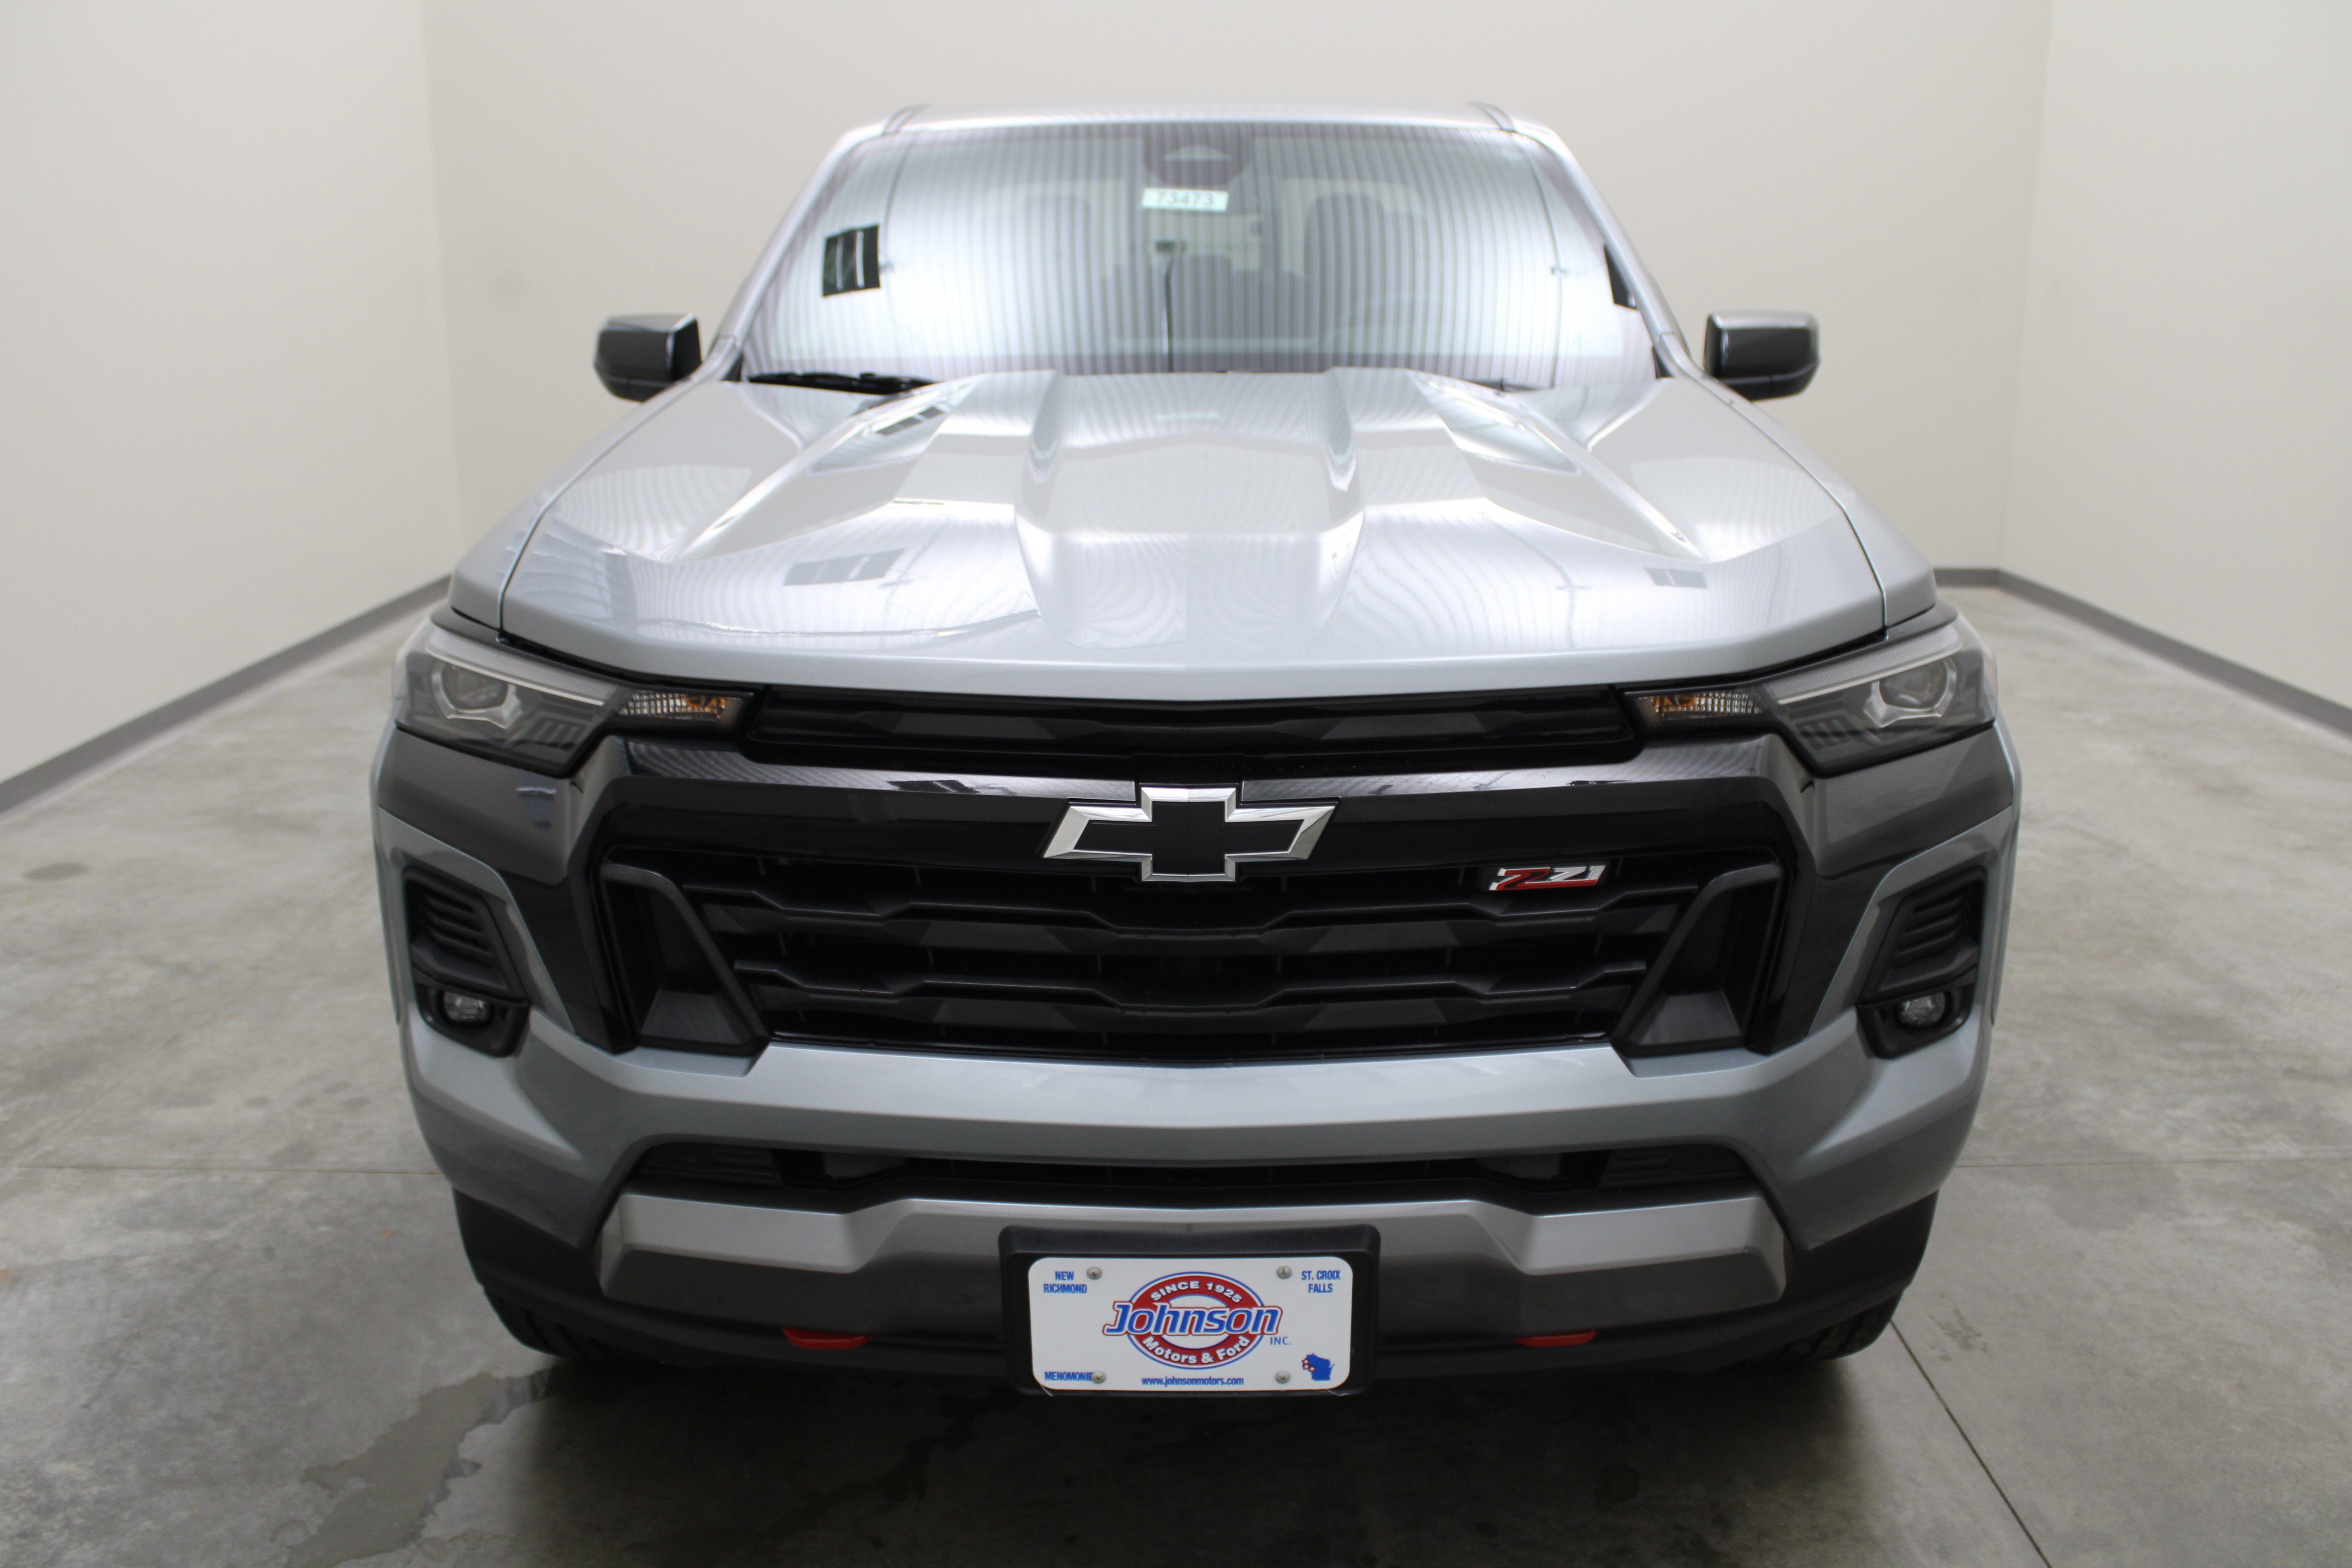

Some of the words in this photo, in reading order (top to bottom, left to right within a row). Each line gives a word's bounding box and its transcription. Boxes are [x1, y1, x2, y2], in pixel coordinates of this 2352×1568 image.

[1489, 865, 1606, 891] Z71
[1055, 1271, 1074, 1281] NEW
[1301, 1270, 1314, 1280] ST.
[1316, 1270, 1341, 1280] CROIX
[1043, 1284, 1087, 1294] RICHMOND
[1150, 1281, 1200, 1301] SINCE
[1207, 1282, 1243, 1303] 1925
[1308, 1283, 1333, 1293] FALLS
[1103, 1302, 1283, 1335] Johnson
[1270, 1336, 1292, 1345] INC.
[1142, 1336, 1197, 1364] Motors
[1200, 1352, 1214, 1364] &
[1216, 1335, 1250, 1361] Ford
[1142, 1376, 1244, 1387] www.johnsonmotors.com
